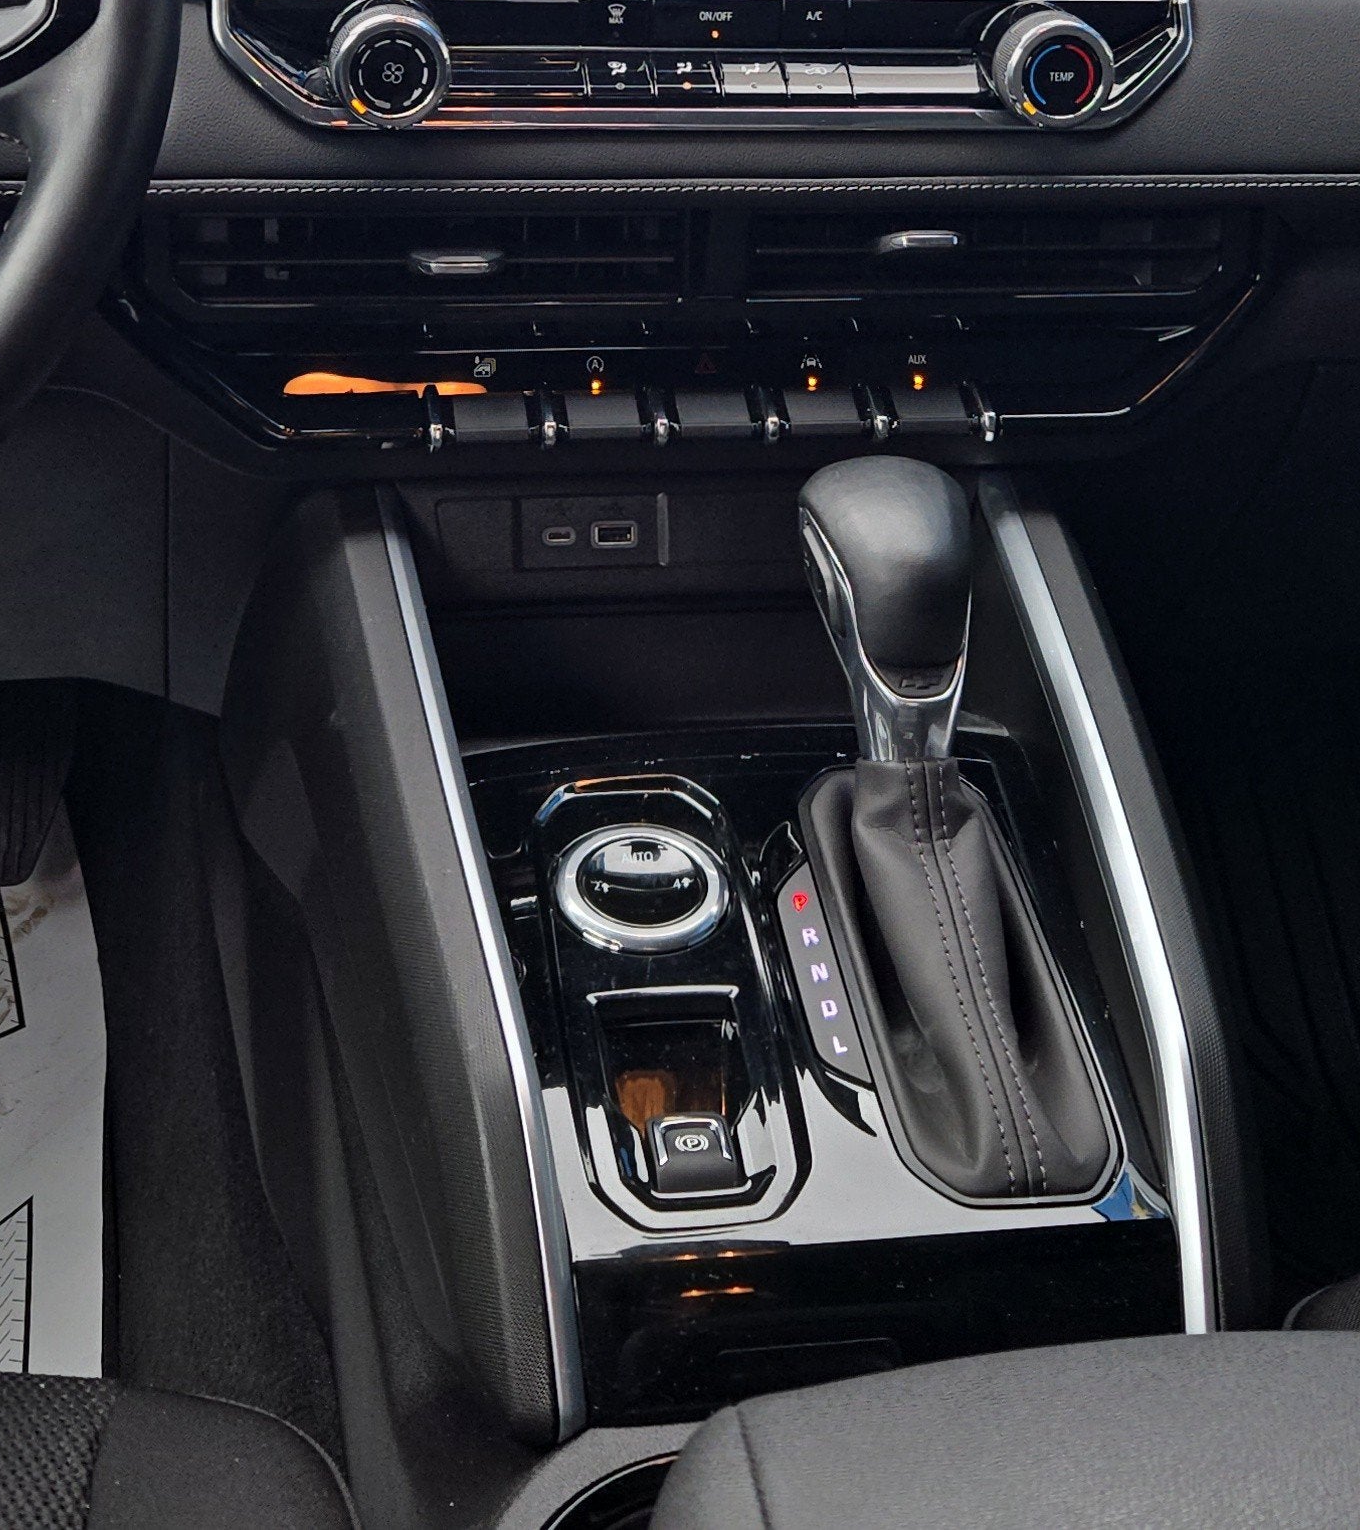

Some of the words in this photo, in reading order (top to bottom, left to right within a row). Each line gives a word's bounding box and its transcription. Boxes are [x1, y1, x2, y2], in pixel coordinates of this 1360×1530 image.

[699, 11, 733, 22] ON/OFF
[806, 11, 823, 21] A/C
[1049, 71, 1075, 82] TEMP
[907, 354, 927, 365] AUX
[793, 892, 809, 912] P
[801, 927, 820, 947] R
[810, 962, 830, 983] N
[820, 999, 839, 1019] D
[832, 1035, 848, 1054] L
